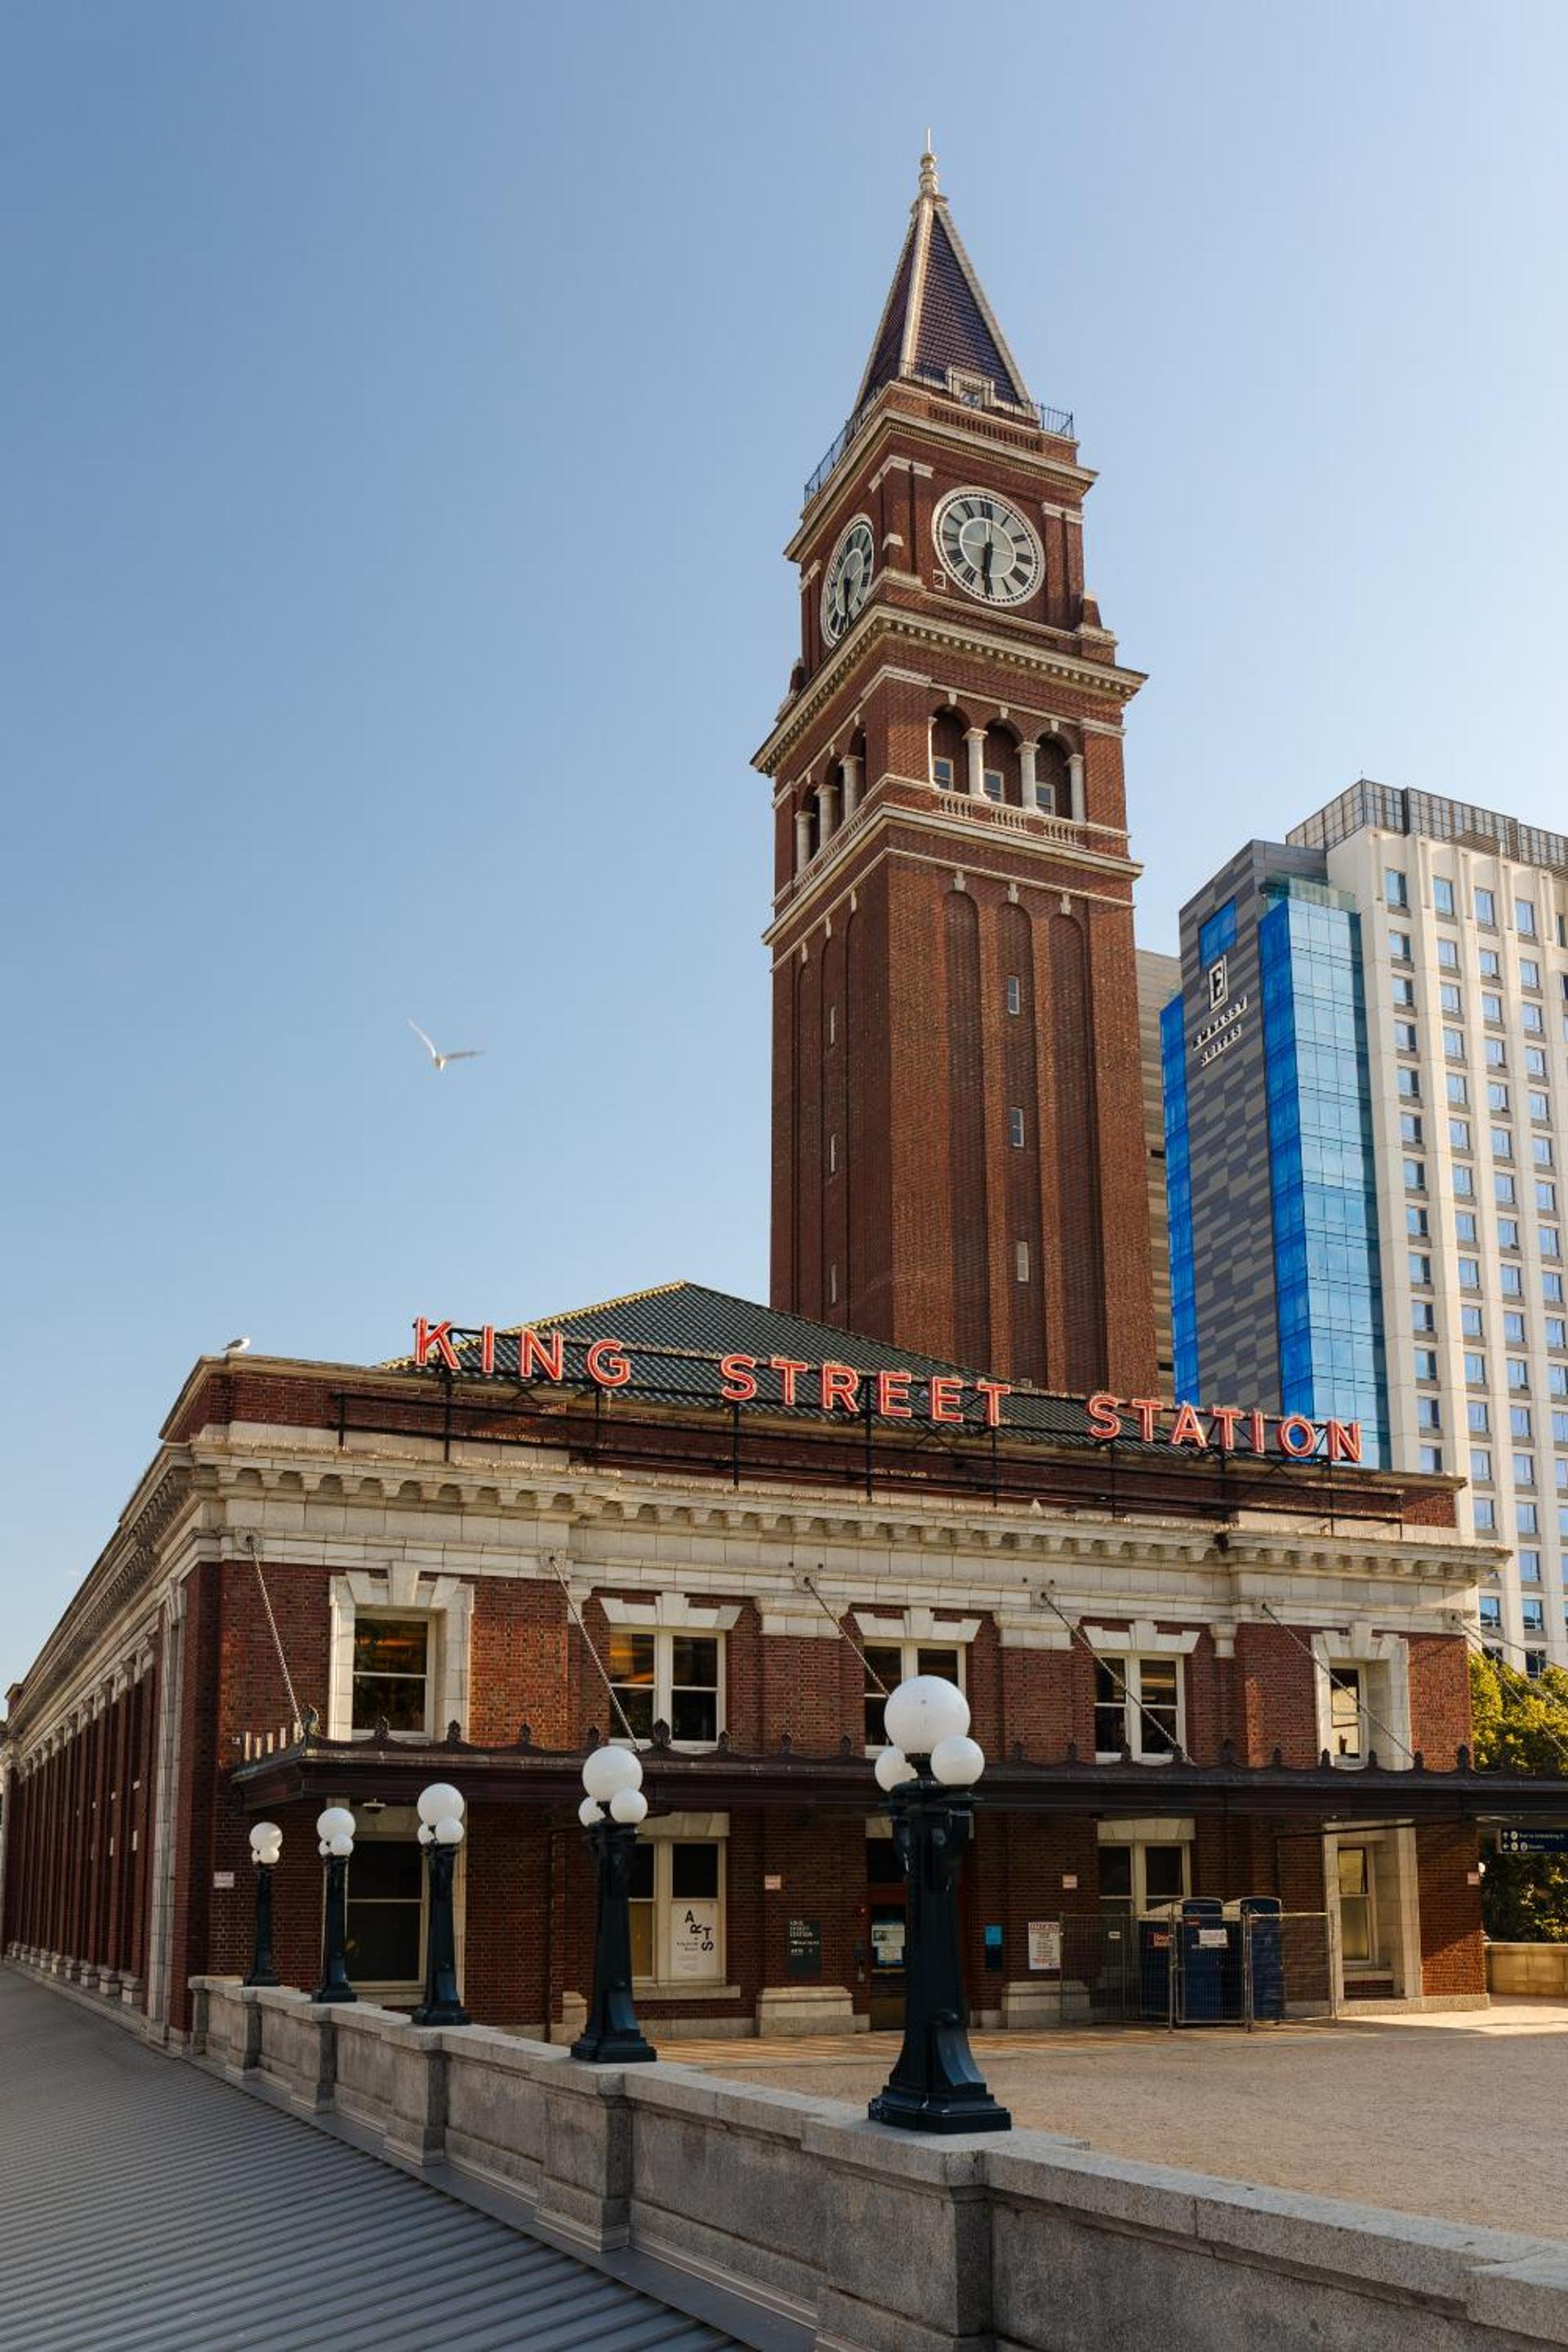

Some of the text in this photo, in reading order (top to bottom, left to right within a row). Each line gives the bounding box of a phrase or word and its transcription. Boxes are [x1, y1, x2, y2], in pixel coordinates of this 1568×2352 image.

[415, 1316, 1362, 1463] KING STREET STATION
[684, 1909, 714, 1951] ARTS
